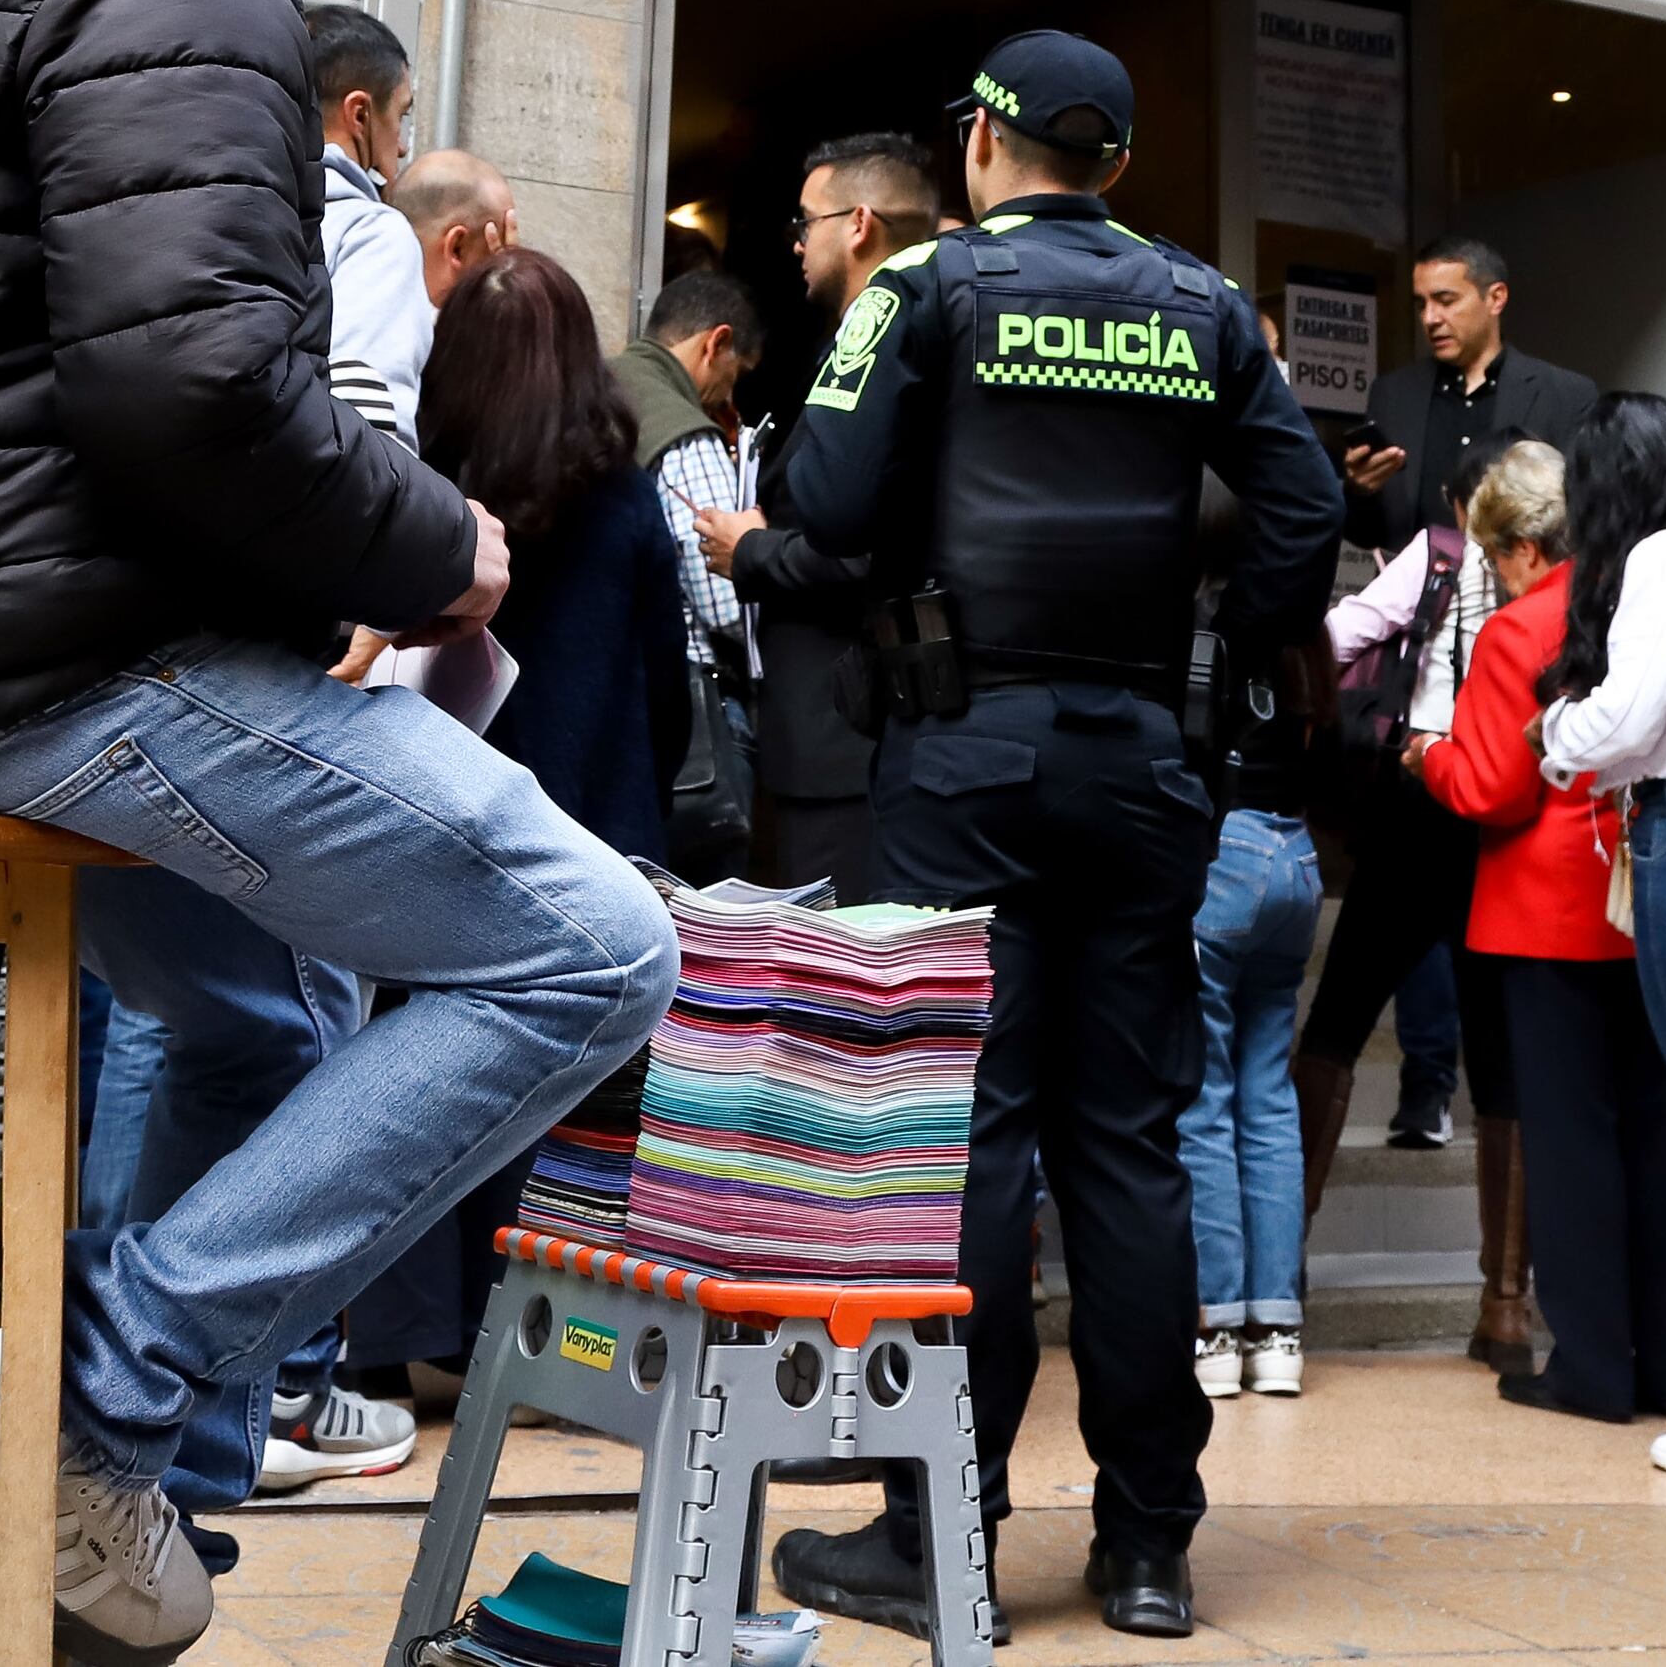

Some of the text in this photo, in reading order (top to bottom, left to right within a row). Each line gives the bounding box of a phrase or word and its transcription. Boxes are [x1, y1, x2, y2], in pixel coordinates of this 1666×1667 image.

[998, 310, 1199, 372] POLICÍA
[1296, 360, 1367, 393] PISO 5
[565, 1324, 615, 1357] Vanyplas
[87, 1537, 108, 1563] adidas
